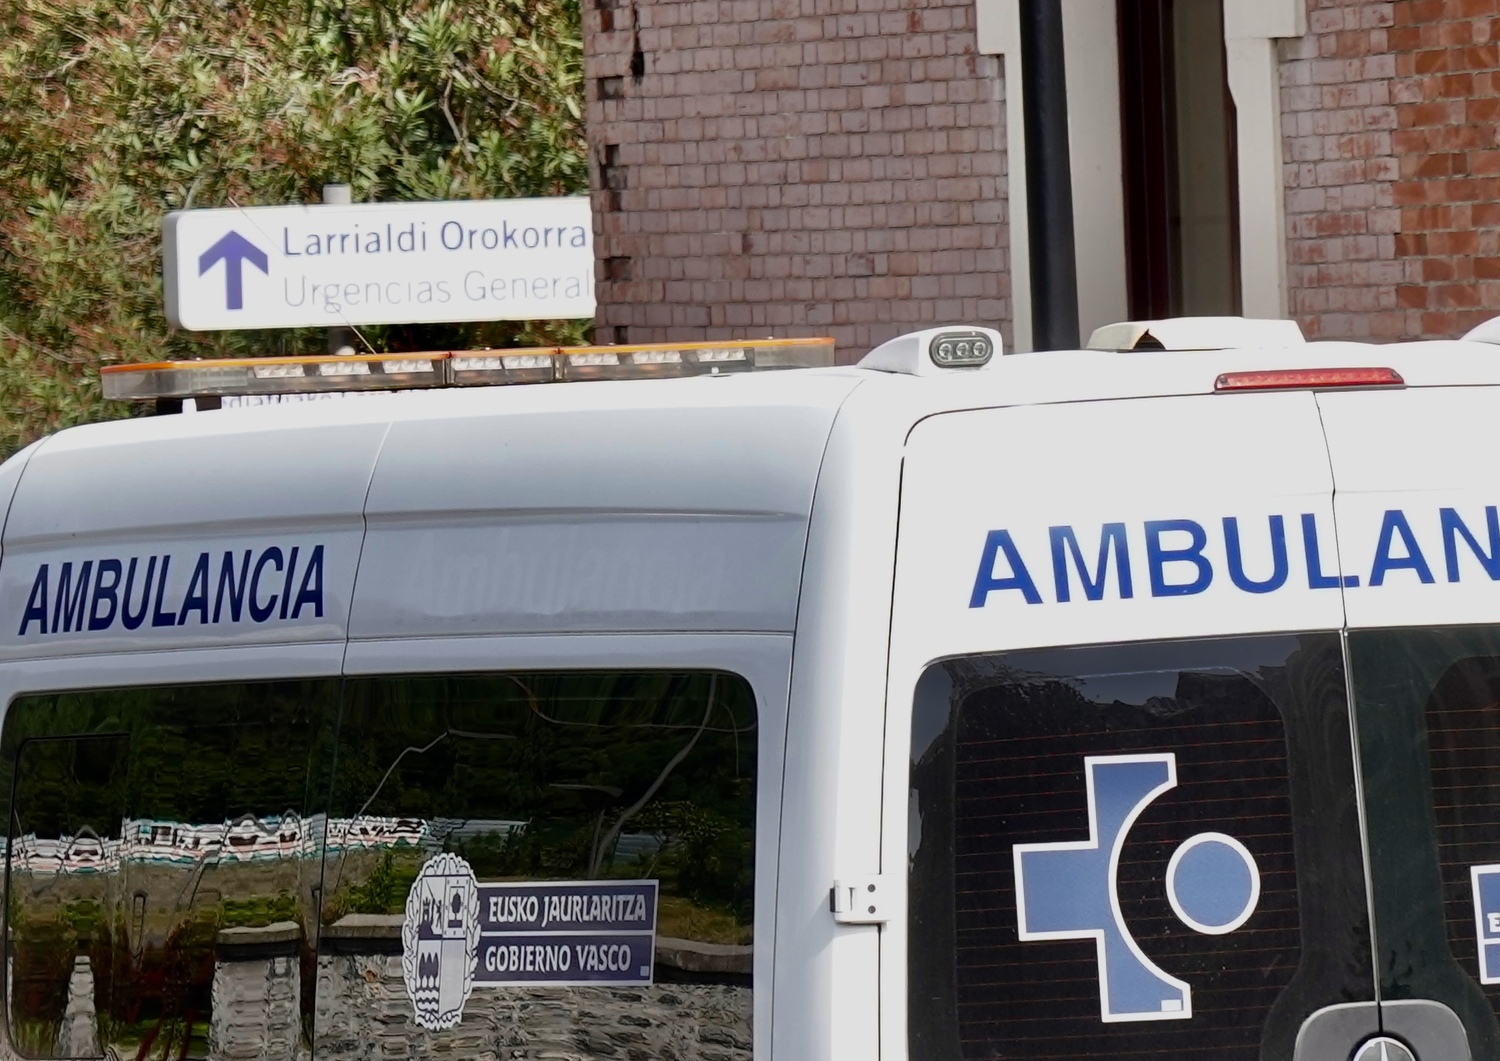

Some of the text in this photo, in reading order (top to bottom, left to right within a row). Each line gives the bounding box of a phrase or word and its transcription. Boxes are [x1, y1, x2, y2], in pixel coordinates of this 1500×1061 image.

[282, 219, 588, 256] Larrialdi Orokorra
[283, 273, 452, 314] Urgencias
[17, 544, 326, 636] AMBULANCIA
[488, 893, 647, 928] EUSKO JAURLARITZA
[485, 943, 632, 973] GOBIERNO VASCO
